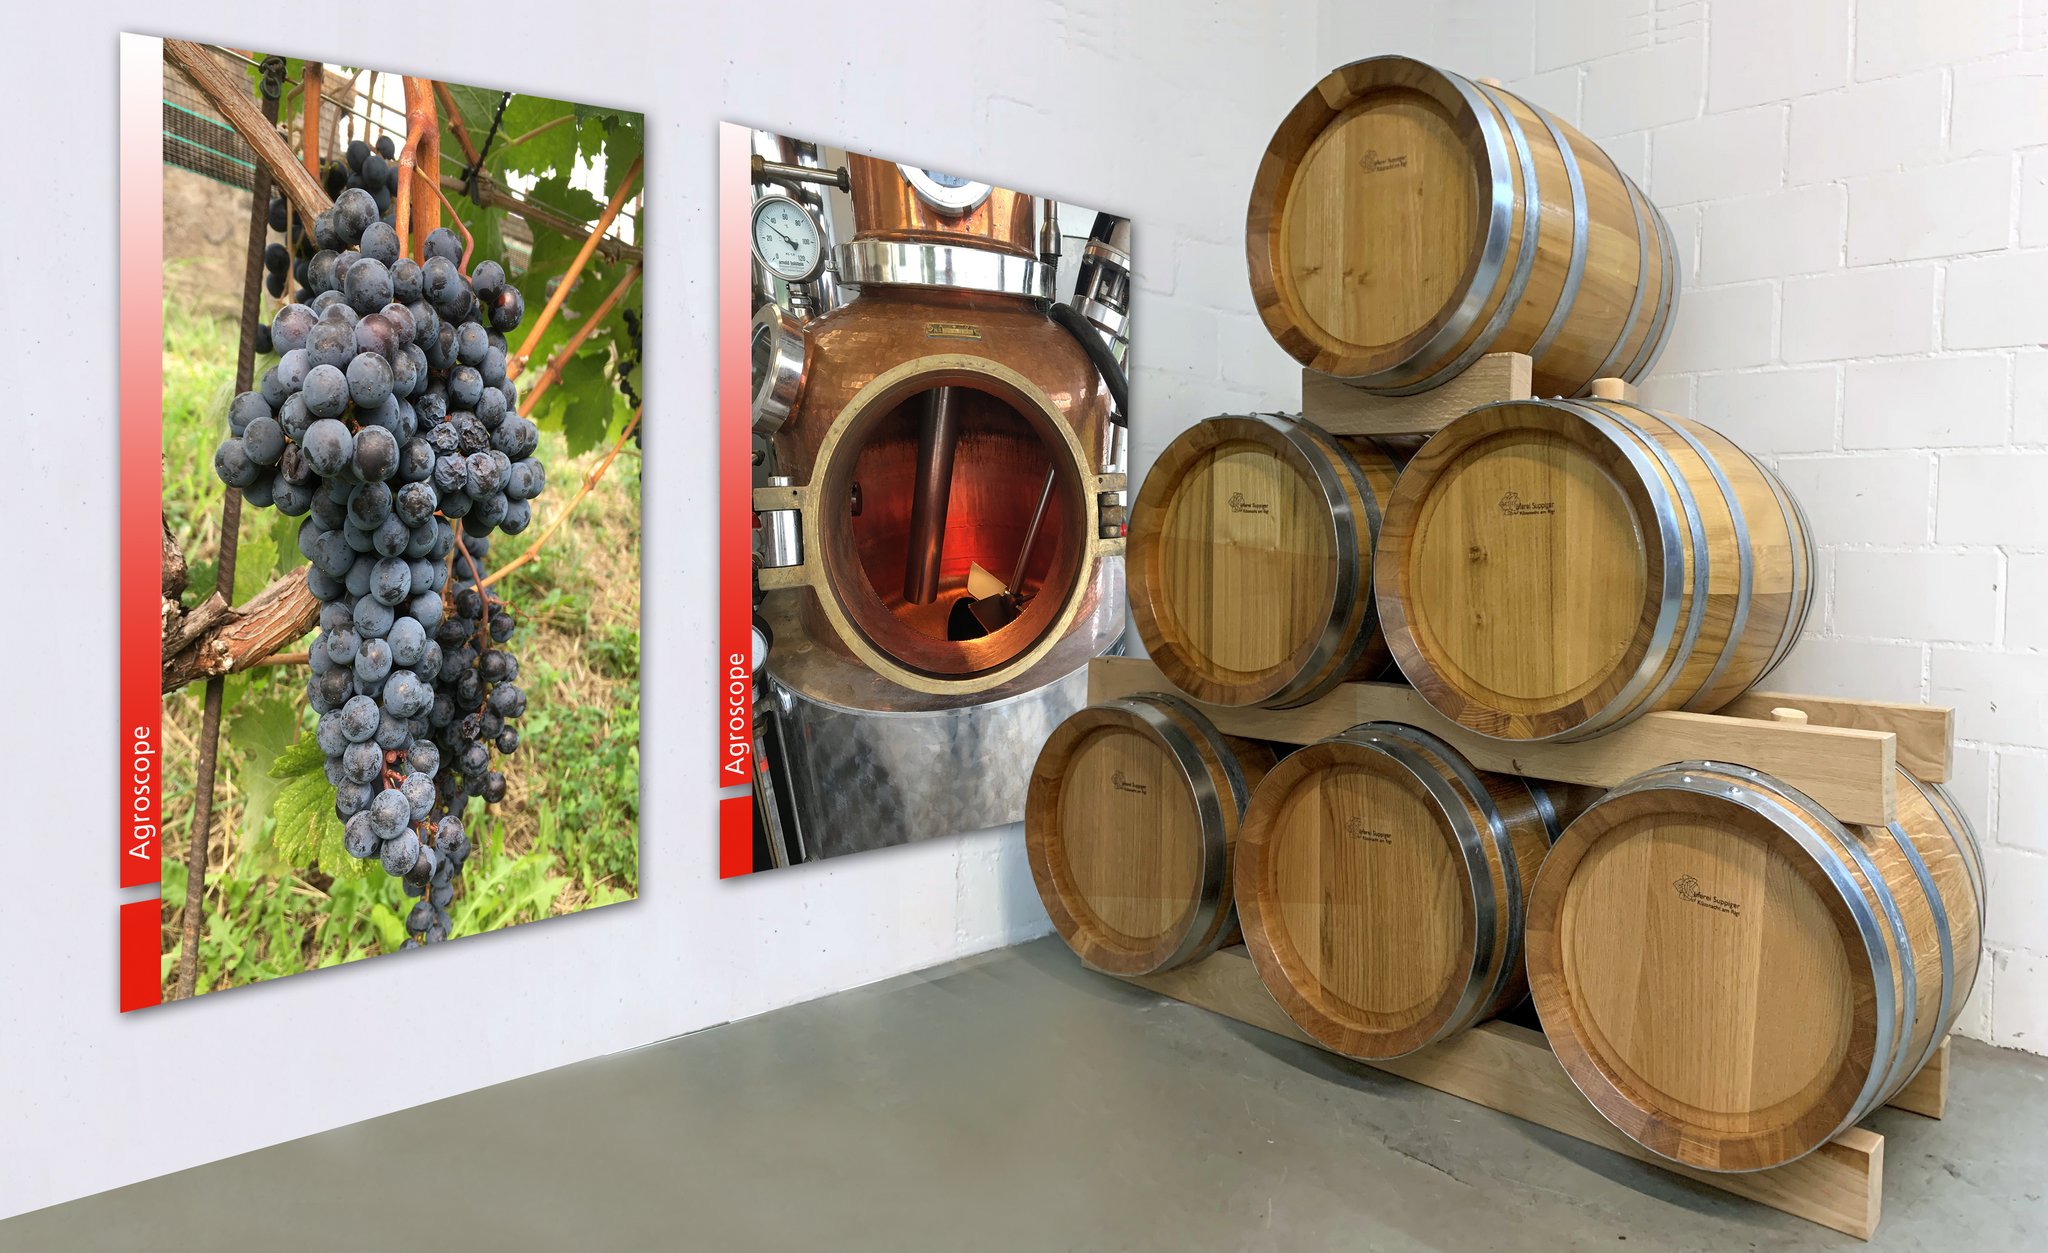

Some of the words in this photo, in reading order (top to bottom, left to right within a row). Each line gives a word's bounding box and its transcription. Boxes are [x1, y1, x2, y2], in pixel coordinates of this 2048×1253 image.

[724, 653, 750, 775] Agroscope
[128, 726, 157, 860] Agroscope
[1713, 896, 1740, 909] Suppiger
